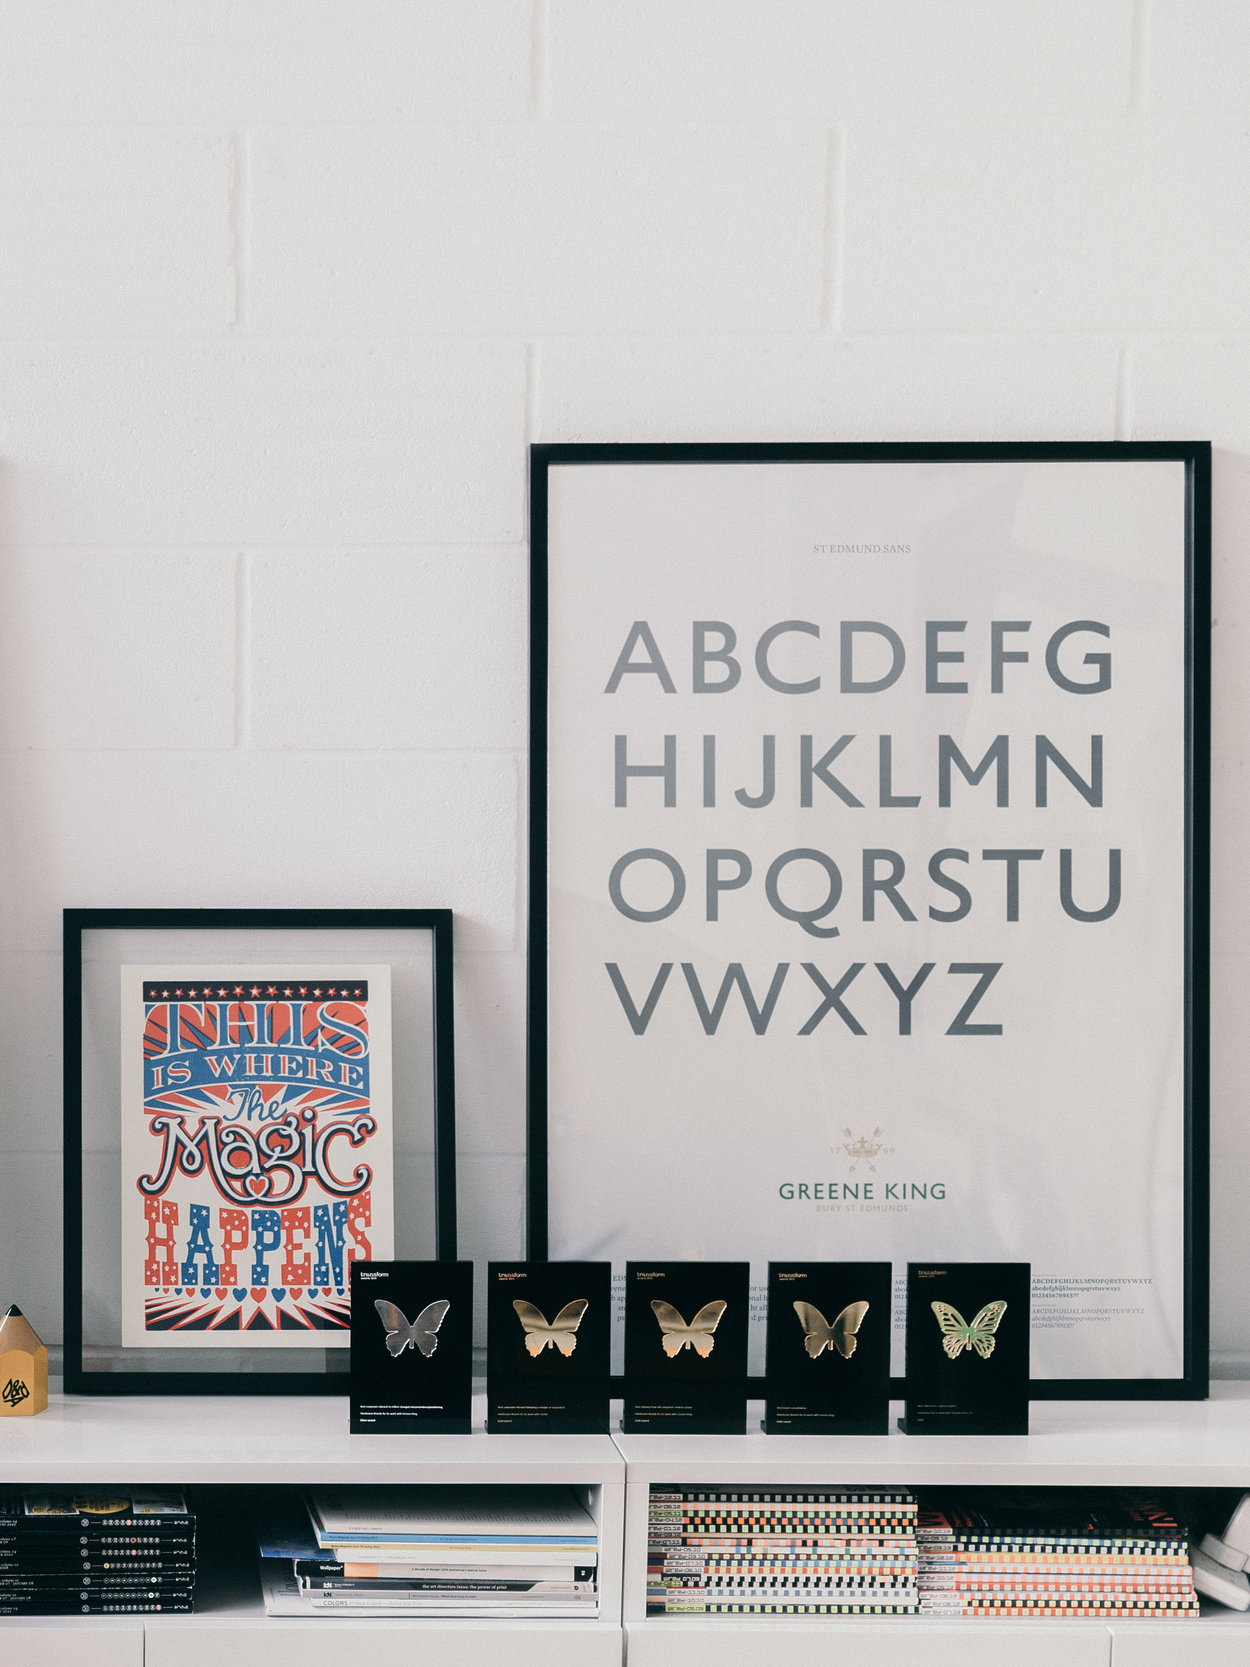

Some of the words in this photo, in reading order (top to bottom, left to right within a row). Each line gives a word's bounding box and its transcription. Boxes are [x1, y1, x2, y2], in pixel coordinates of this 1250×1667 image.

[813, 545, 827, 553] ST
[830, 545, 881, 553] EDMUND
[883, 545, 912, 553] SANS
[604, 620, 1112, 694] ABCDEFG
[614, 735, 1103, 808] HIJKLMN
[608, 848, 1122, 939] OPQRSTU
[144, 1001, 370, 1060] THIS
[604, 963, 1004, 1036] VWXYZ
[151, 1060, 191, 1090] IS
[204, 1053, 364, 1090] WHERE
[223, 1087, 287, 1122] The
[779, 1183, 874, 1200] GREENE
[886, 1183, 946, 1200] KING
[144, 1190, 372, 1286] HAPPENS
